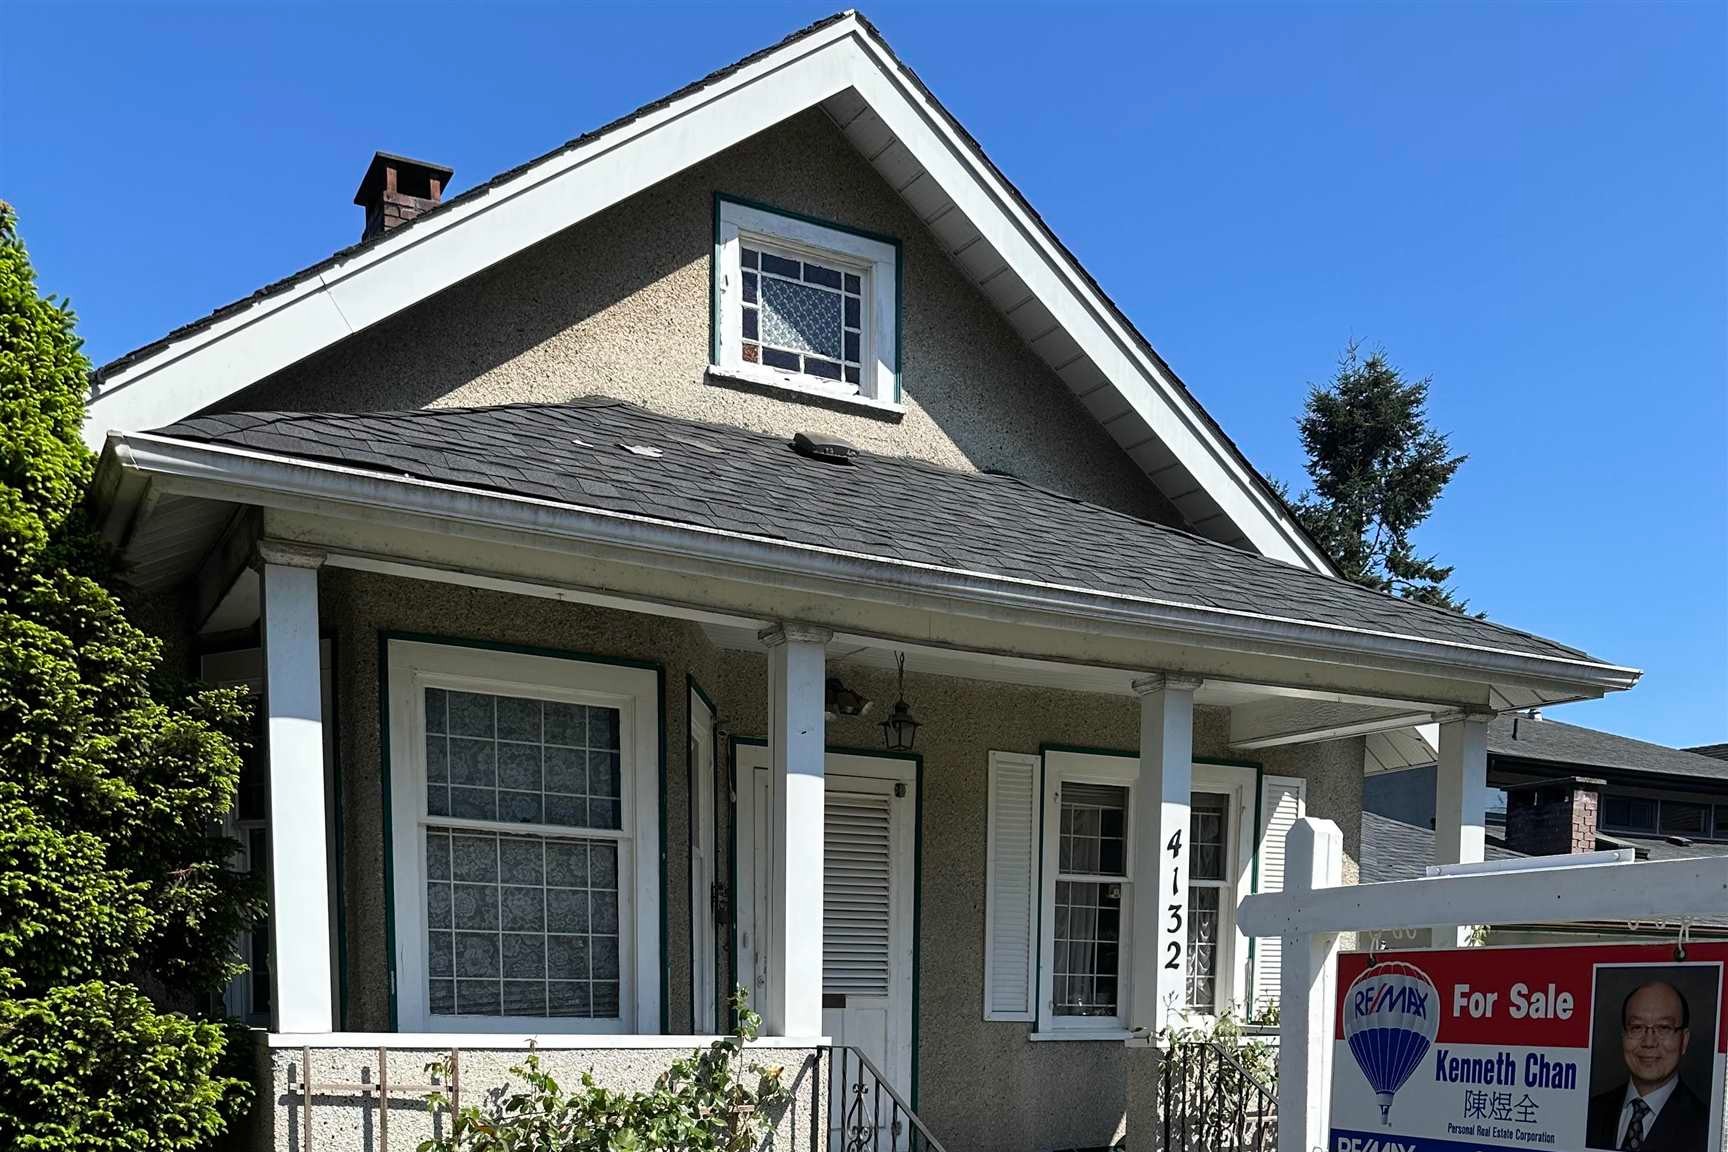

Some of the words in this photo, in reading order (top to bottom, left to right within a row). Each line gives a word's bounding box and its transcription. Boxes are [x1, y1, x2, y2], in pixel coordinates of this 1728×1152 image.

[1165, 828, 1183, 970] 4132
[1355, 983, 1428, 1020] RE/MAX
[1452, 983, 1498, 1019] For
[1508, 982, 1574, 1020] Sale
[1435, 1049, 1516, 1086] Kenneth
[1524, 1052, 1577, 1090] Chan
[1463, 1089, 1540, 1124] 陳煜全
[1447, 1122, 1475, 1136] Personal
[1476, 1125, 1491, 1138] Real
[1492, 1126, 1514, 1140] Estate
[1515, 1128, 1555, 1144] Corporation
